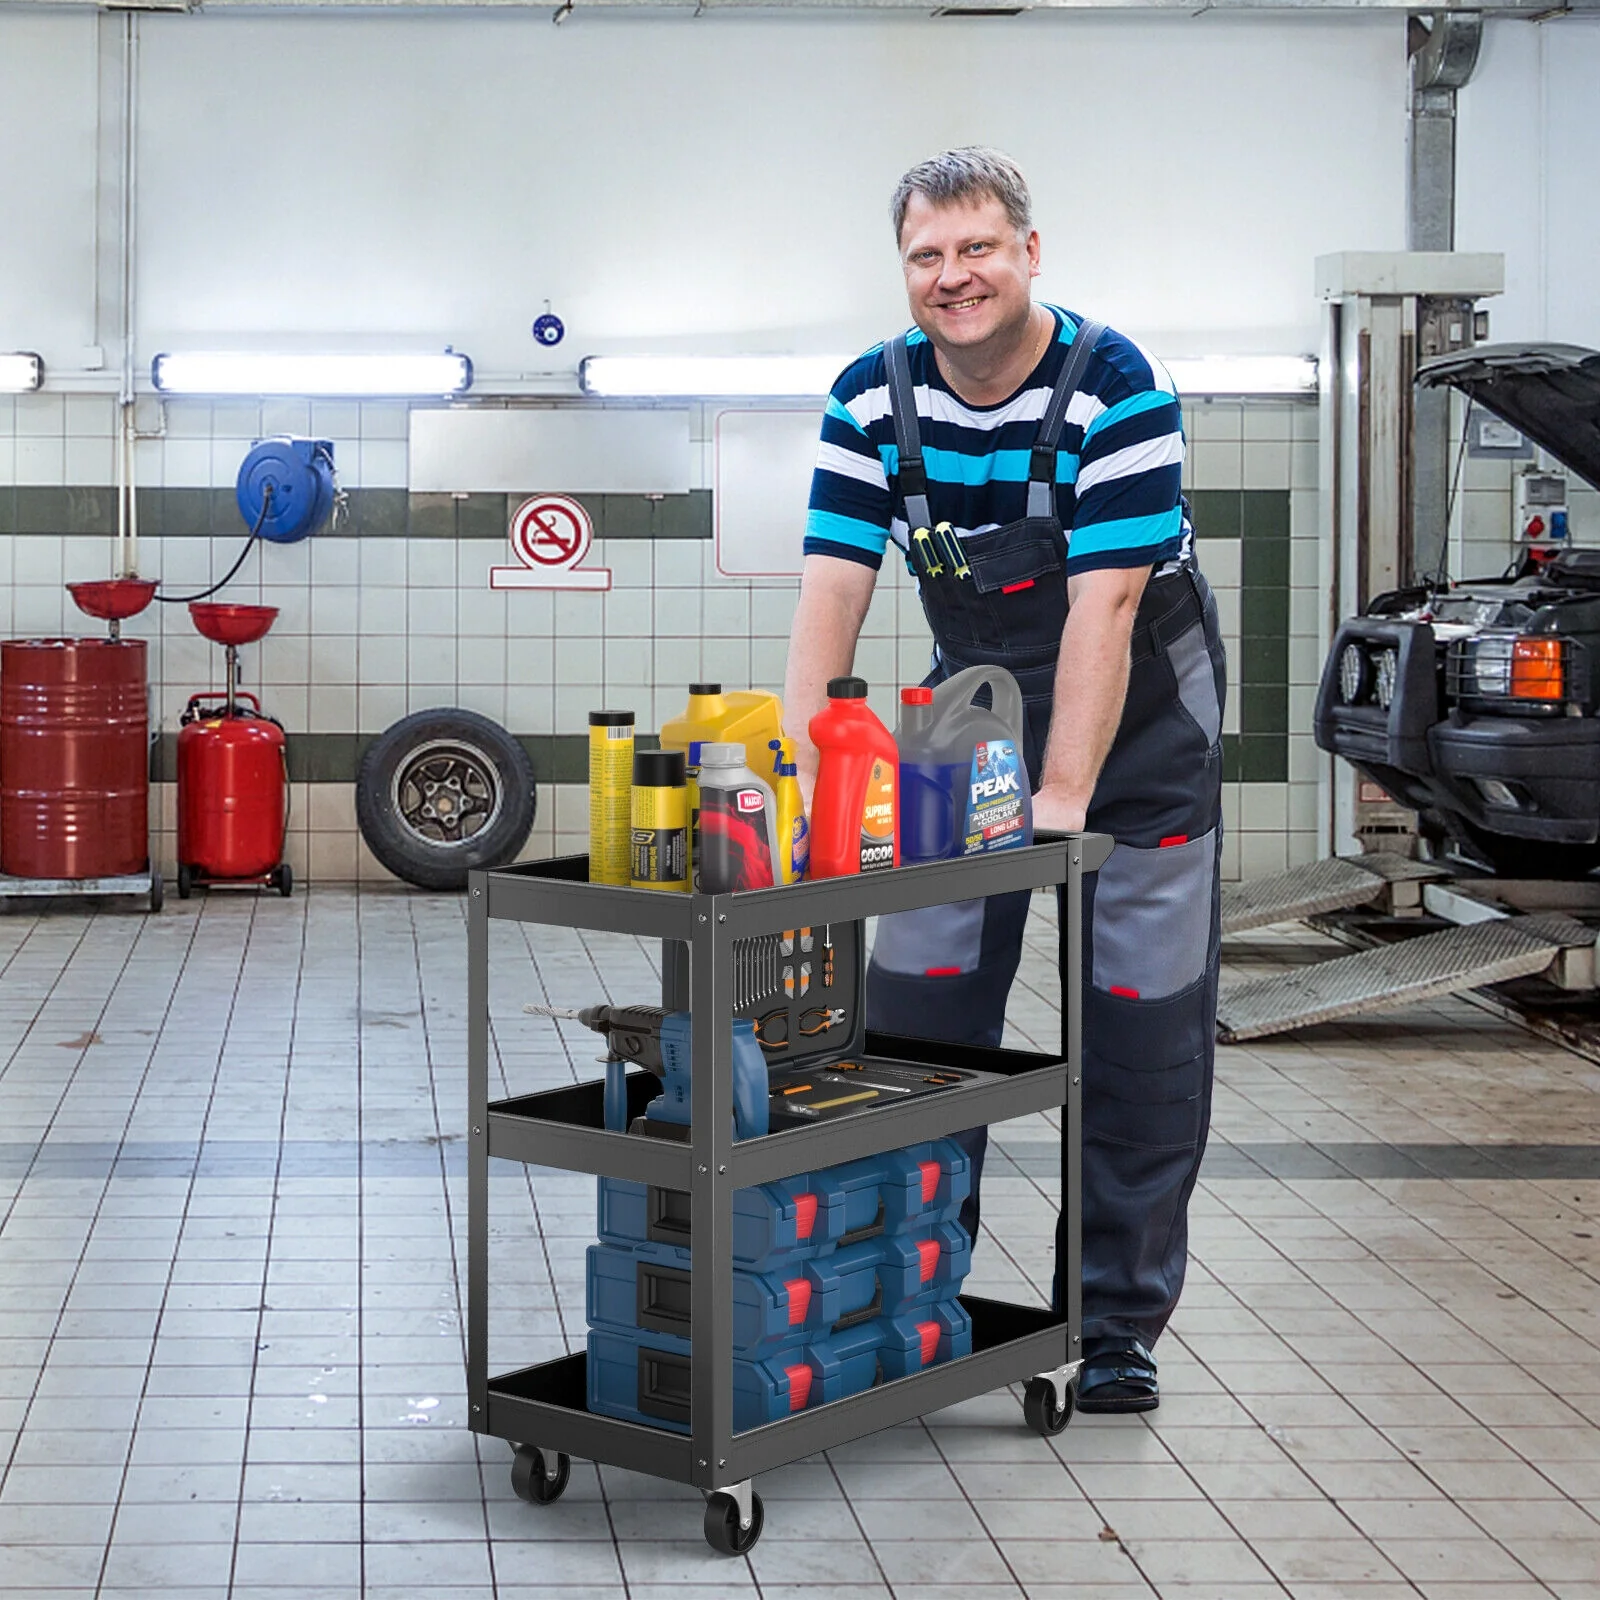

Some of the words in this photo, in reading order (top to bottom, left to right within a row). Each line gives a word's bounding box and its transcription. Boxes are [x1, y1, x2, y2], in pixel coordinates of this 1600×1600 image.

[972, 772, 1020, 805] PEAK
[973, 800, 1021, 822] ANTIFREEZE
[990, 823, 1006, 835] LONG
[1006, 818, 1019, 830] LIFE
